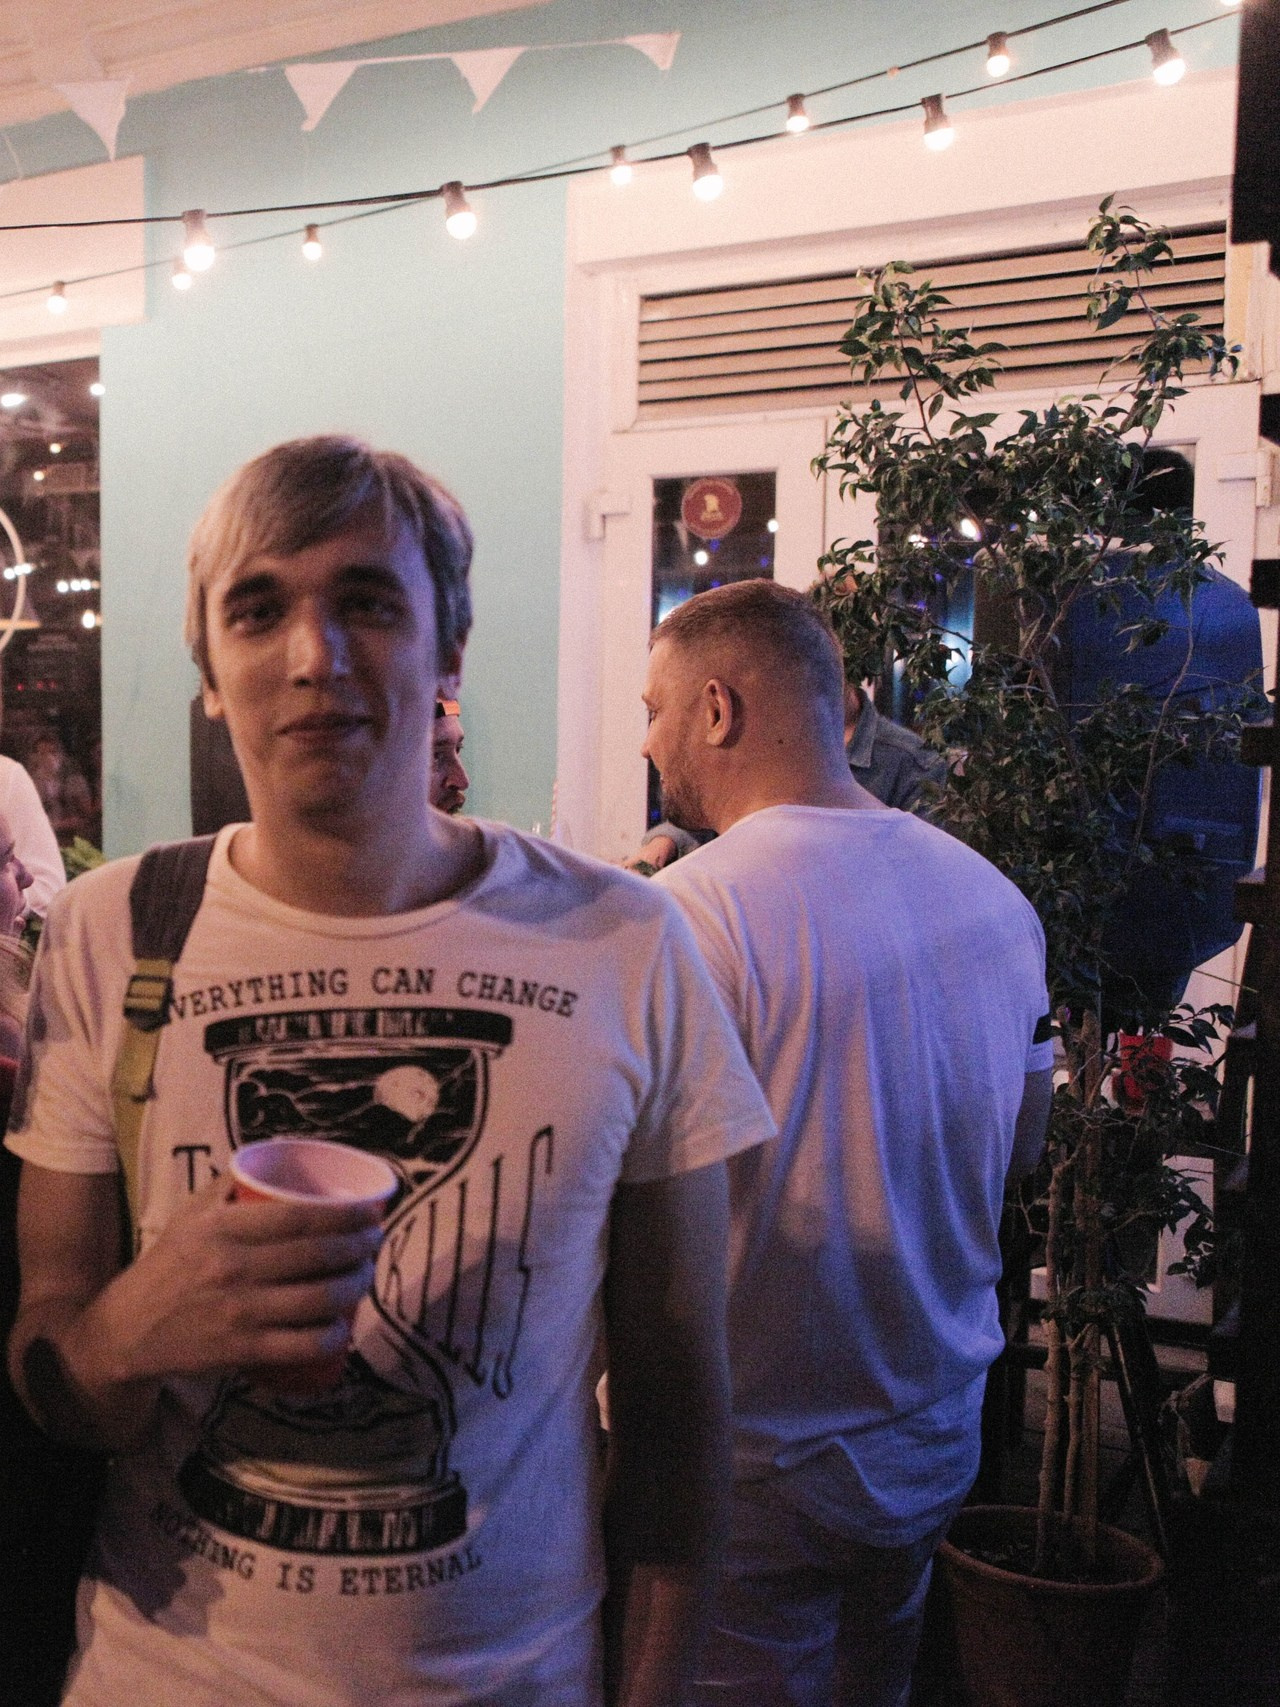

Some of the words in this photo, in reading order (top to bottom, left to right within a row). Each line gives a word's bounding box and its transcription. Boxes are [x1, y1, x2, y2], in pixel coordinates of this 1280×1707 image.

[169, 969, 348, 1020] VERYTHING
[371, 967, 434, 994] CAN
[457, 972, 578, 1018] CHANGE
[276, 1563, 316, 1592] IS
[339, 1548, 484, 1597] ETERNAL
